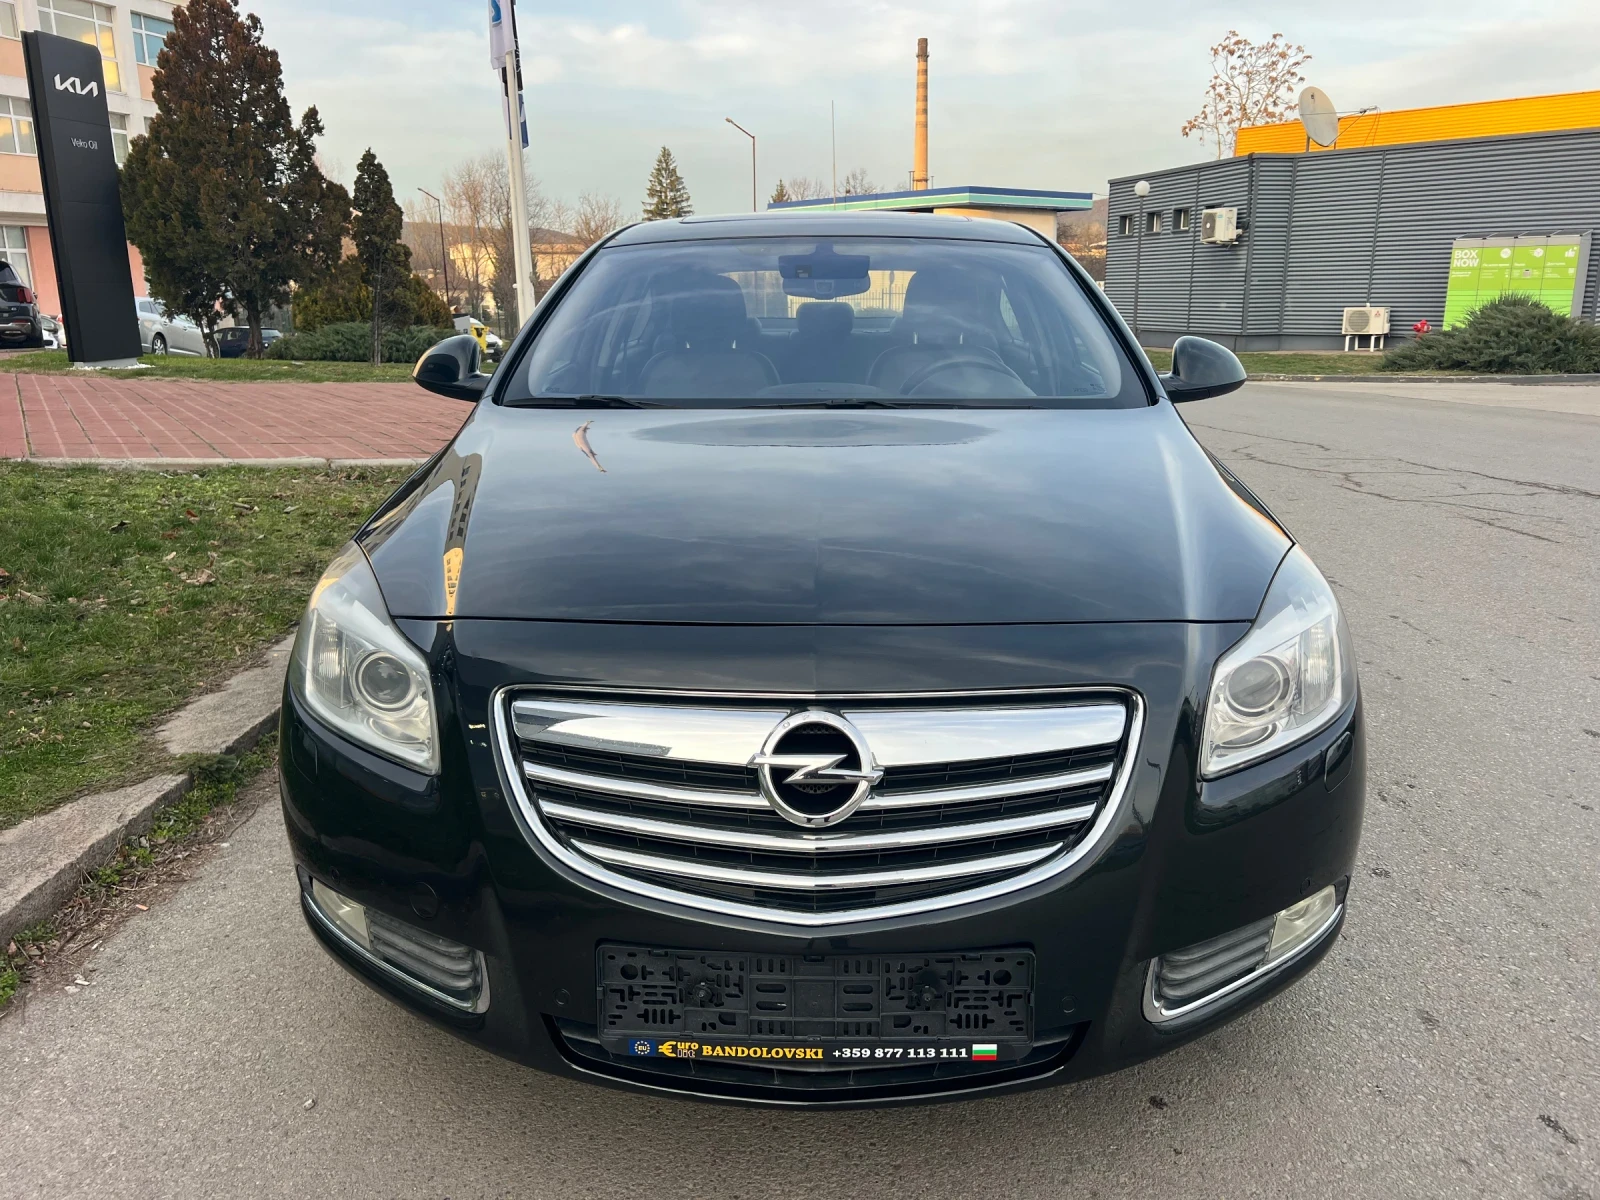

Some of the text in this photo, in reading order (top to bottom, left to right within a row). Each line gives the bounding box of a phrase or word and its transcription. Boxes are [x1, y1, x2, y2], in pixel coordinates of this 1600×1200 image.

[54, 74, 99, 97] KIA
[71, 137, 98, 150] Veko Oil
[1454, 249, 1479, 259] BOX
[1453, 258, 1480, 268] NOW
[702, 1045, 824, 1059] BANDOLOVSKI
[832, 1048, 871, 1058] +359
[874, 1048, 904, 1058] 877
[907, 1048, 936, 1058] 113
[940, 1048, 969, 1058] 111
